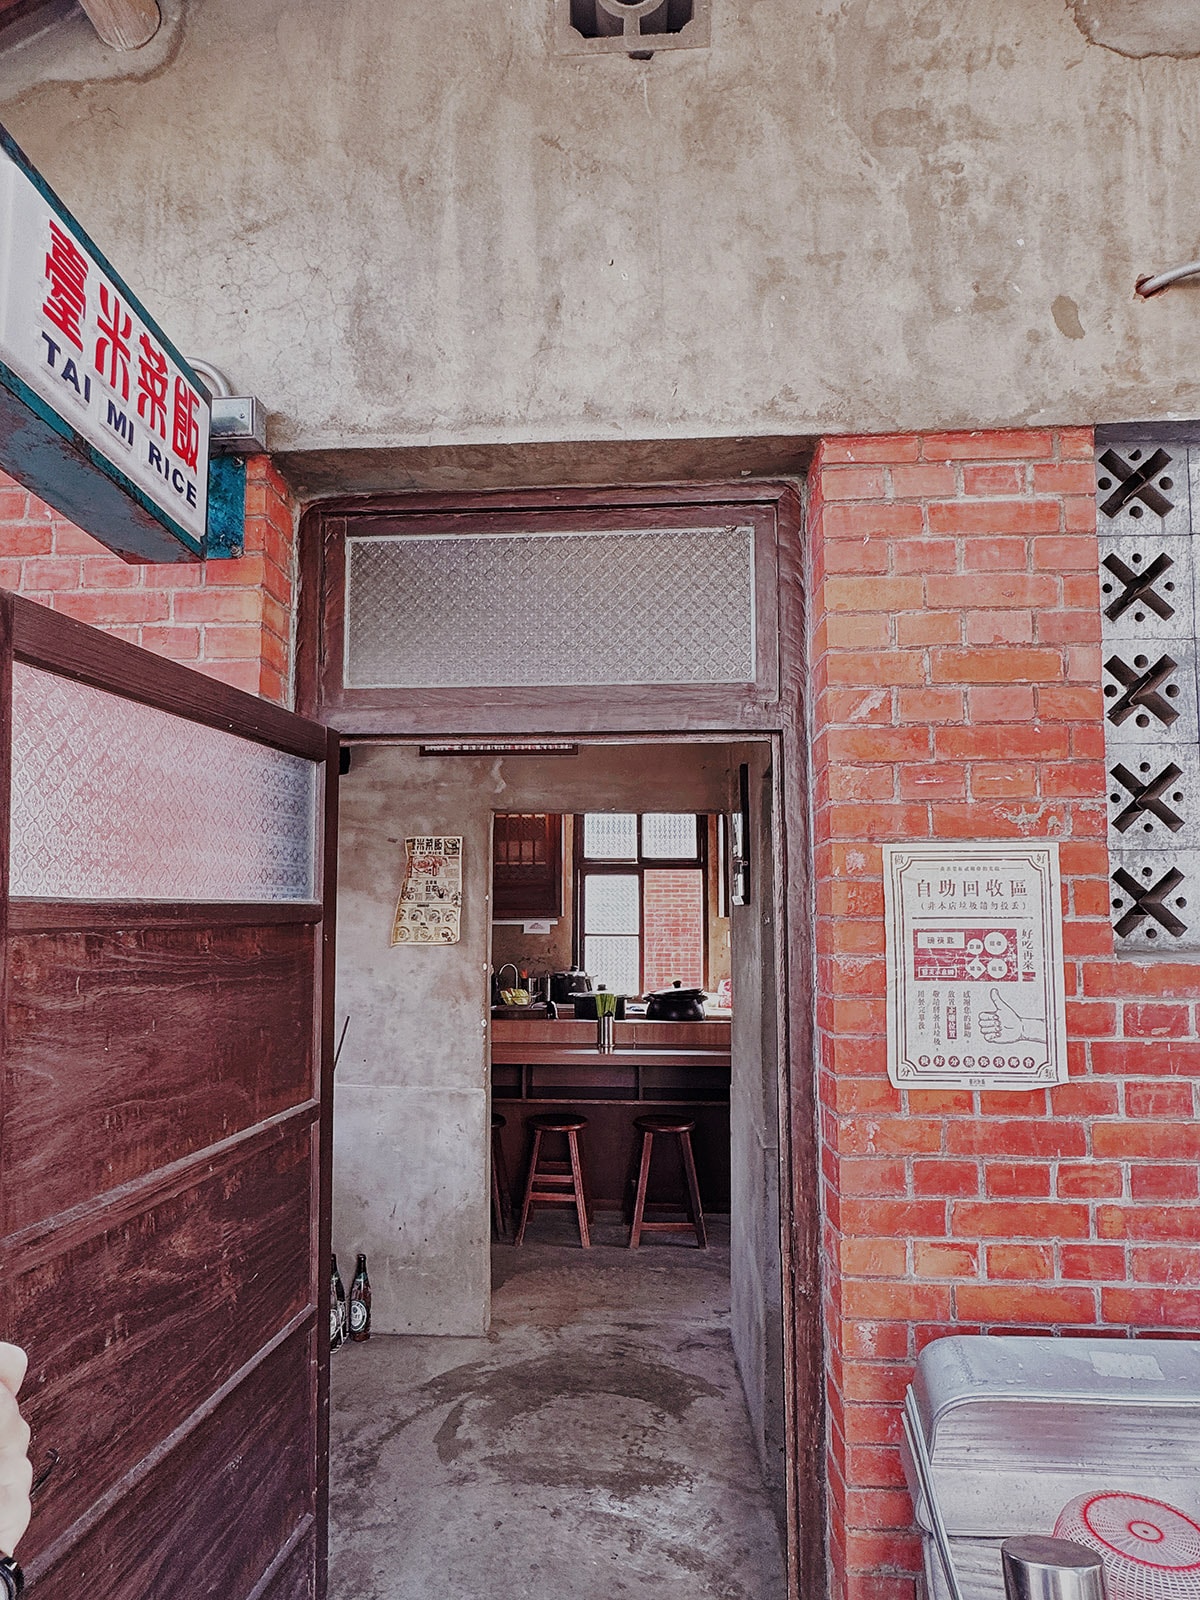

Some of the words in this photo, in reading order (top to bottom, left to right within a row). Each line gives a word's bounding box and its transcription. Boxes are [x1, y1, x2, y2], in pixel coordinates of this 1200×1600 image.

[41, 331, 92, 403] TAI
[107, 403, 134, 447] MI
[148, 440, 197, 509] RICE
[42, 219, 200, 475] 臺米菜飯
[917, 879, 1028, 898] 自助回收區
